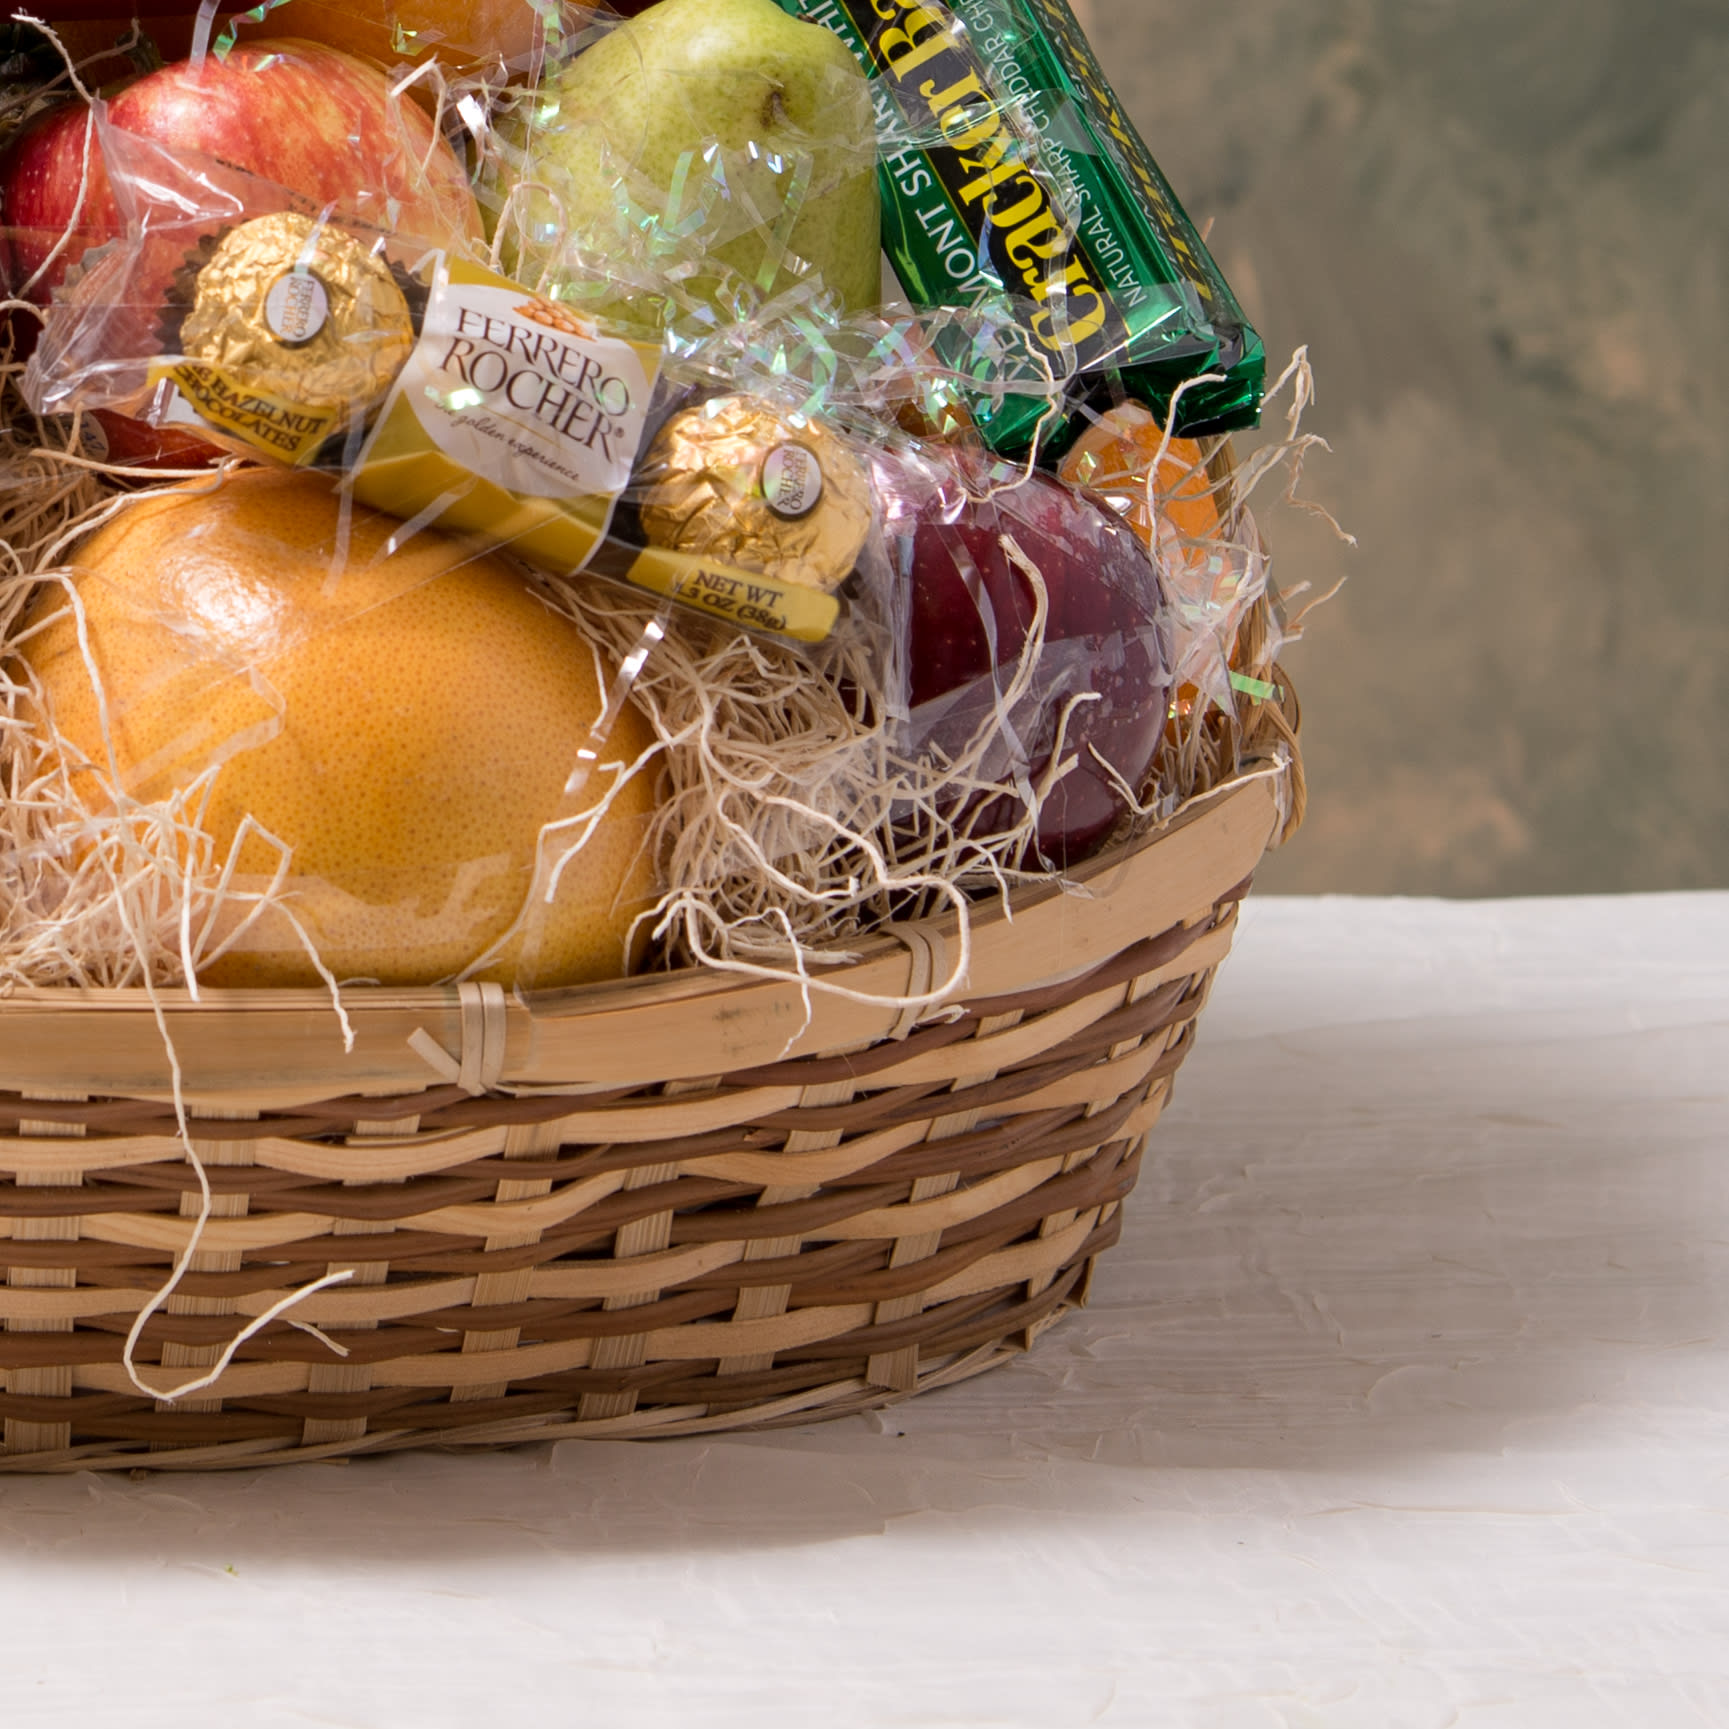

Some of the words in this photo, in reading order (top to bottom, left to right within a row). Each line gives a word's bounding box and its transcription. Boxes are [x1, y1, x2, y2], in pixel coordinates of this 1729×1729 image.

[981, 31, 1053, 136] CHEDDAR
[920, 65, 1105, 352] Cracker
[1036, 131, 1093, 209] SHARP
[914, 203, 1028, 382] VEMONT
[1077, 204, 1147, 308] NATURAL
[211, 374, 328, 436] HAZELNUT
[456, 306, 630, 417] FERRERO
[694, 569, 743, 596] NET
[747, 583, 785, 608] WT
[703, 593, 737, 612] OZ
